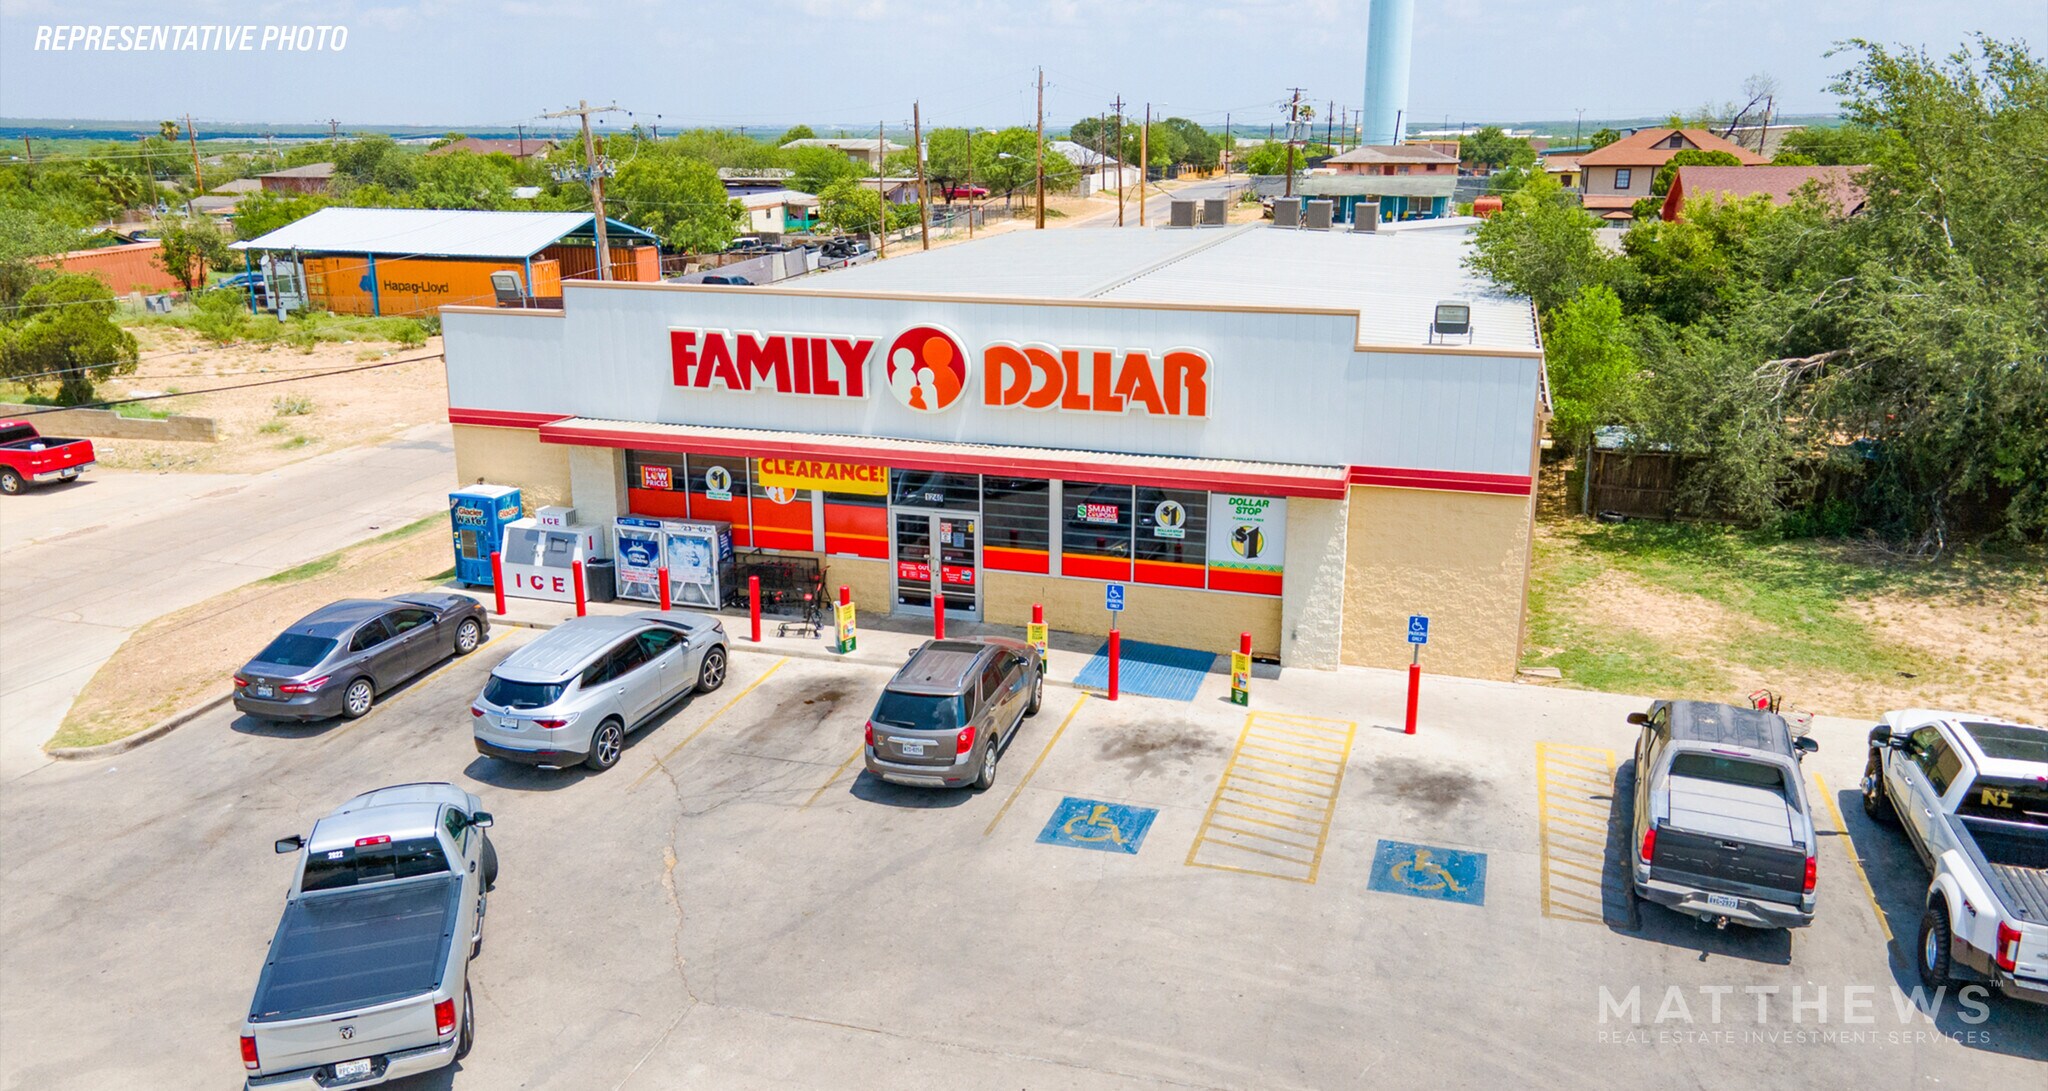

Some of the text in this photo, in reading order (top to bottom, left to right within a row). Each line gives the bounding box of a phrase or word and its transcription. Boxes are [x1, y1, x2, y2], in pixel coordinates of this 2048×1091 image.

[384, 280, 449, 294] Hapag-Lloyd
[670, 331, 1208, 417] FAMILY DOLLAR
[761, 458, 885, 483] CLEARANCE!
[645, 472, 668, 481] LOW
[646, 480, 669, 488] PRICES
[1228, 497, 1270, 508] DOLLAR
[458, 506, 483, 517] Glacier
[498, 507, 519, 519] Glacier
[1088, 504, 1117, 513] SMART
[1235, 507, 1262, 515] STOP
[456, 515, 488, 526] Water
[1088, 511, 1117, 519] COUPONS
[542, 517, 560, 526] ICE
[515, 573, 566, 593] ICE
